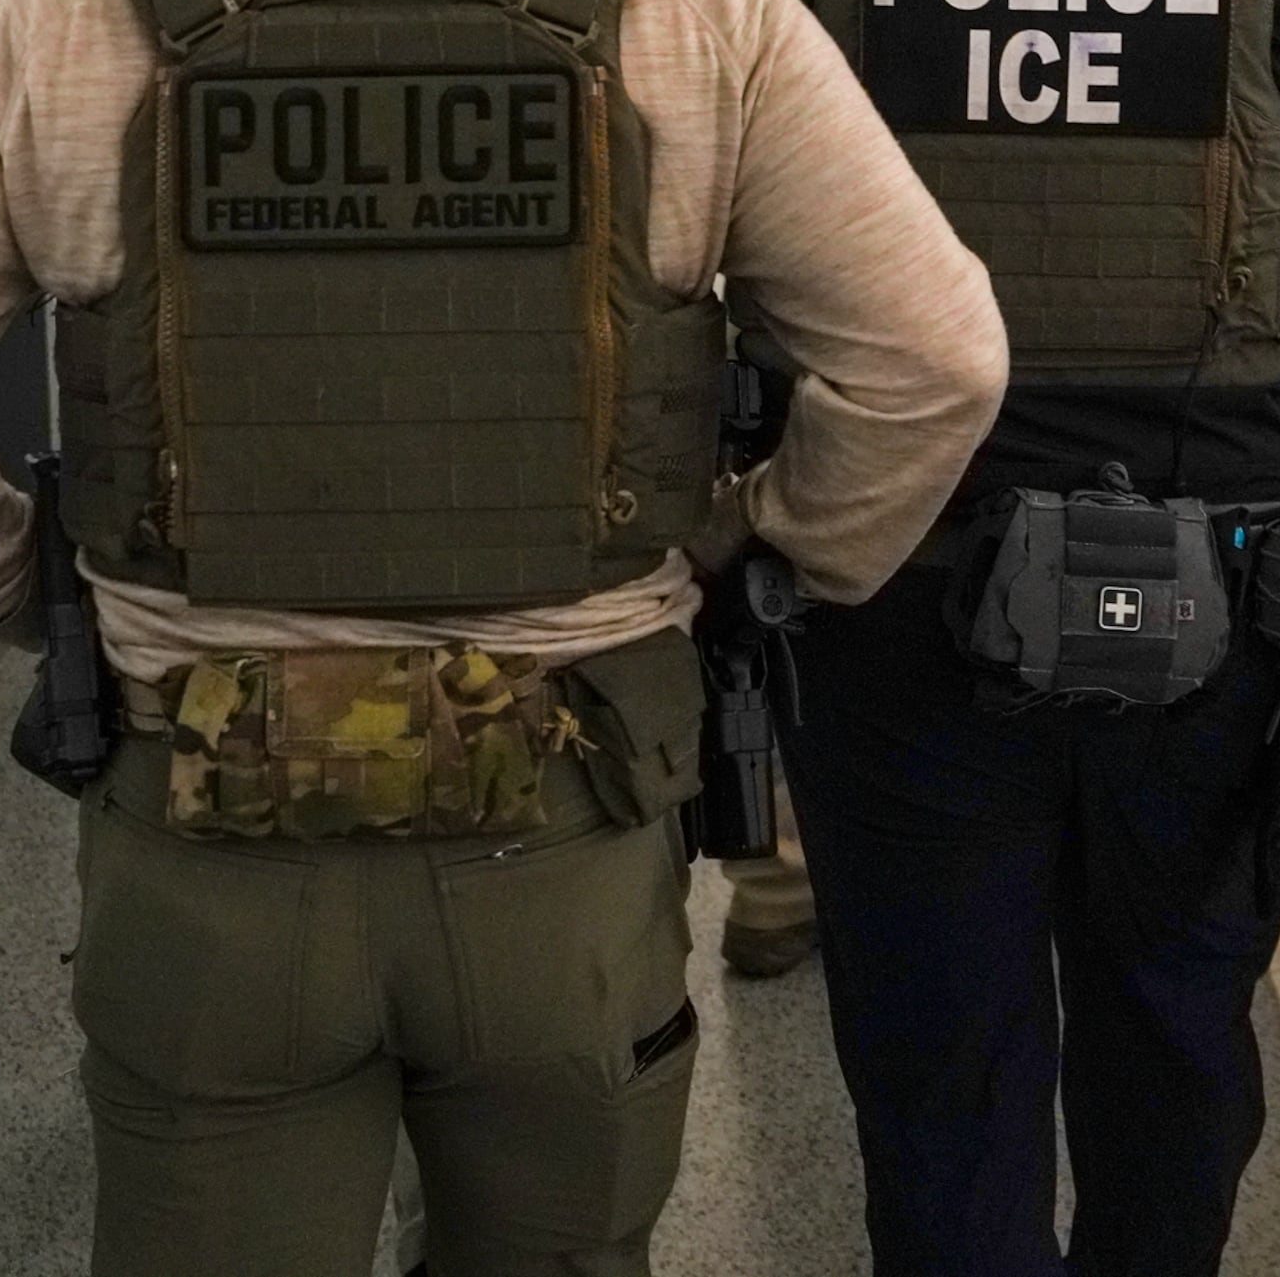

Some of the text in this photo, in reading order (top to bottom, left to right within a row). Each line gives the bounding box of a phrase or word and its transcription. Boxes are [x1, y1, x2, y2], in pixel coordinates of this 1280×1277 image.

[967, 29, 1122, 124] ICE
[202, 84, 557, 187] POLICE
[206, 191, 555, 232] FEDERAL AGENT
